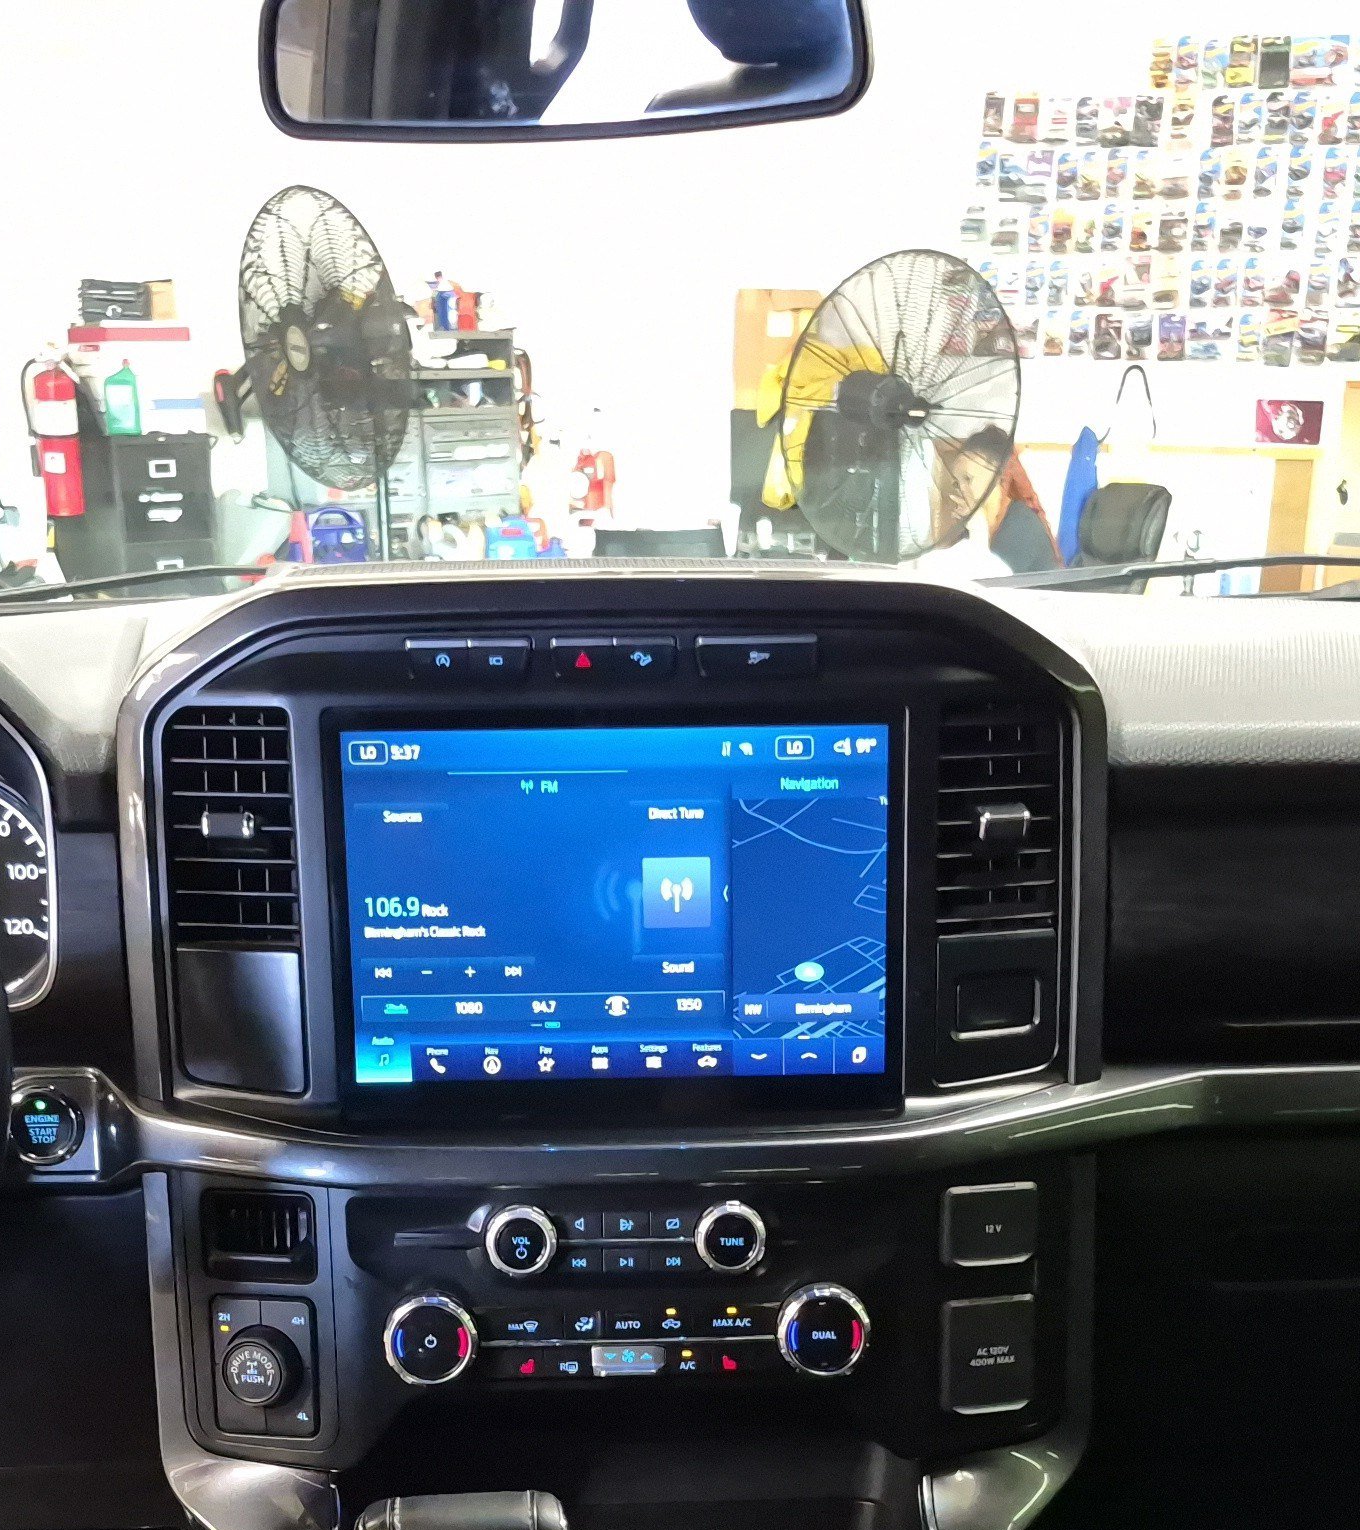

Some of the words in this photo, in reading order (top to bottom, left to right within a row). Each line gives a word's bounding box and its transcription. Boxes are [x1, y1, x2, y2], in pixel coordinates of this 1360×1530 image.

[541, 780, 558, 793] FM
[780, 777, 839, 792] Navigation
[383, 810, 423, 823] Sources
[648, 808, 677, 820] Direct
[679, 807, 704, 819] Tune
[6, 863, 39, 880] 100
[364, 896, 420, 918] 106.9
[421, 904, 449, 917] Rock
[4, 918, 34, 935] 120
[364, 926, 429, 940] Birmingham's
[430, 925, 461, 938] Classic
[462, 925, 486, 937] Rock
[662, 961, 695, 974] Sound
[531, 1000, 557, 1013] 94.7
[795, 1003, 852, 1016] Birmingham
[426, 1047, 449, 1056] Phone
[692, 1043, 722, 1053] Features
[24, 1114, 60, 1124] ENGINE
[29, 1127, 58, 1136] START
[31, 1136, 57, 1144] STOP
[511, 1236, 530, 1246] VOL
[719, 1236, 745, 1247] TUNE
[507, 1323, 524, 1332] MAX
[615, 1320, 641, 1330] AUTO
[712, 1318, 733, 1328] MAX
[734, 1317, 752, 1327] A/C
[811, 1330, 837, 1340] DUAL
[976, 1347, 988, 1357] AC
[231, 1350, 251, 1374] DRIVE
[251, 1350, 275, 1375] MODE
[679, 1361, 696, 1371] A/C
[970, 1357, 995, 1367] 400W
[997, 1355, 1015, 1365] MAX
[241, 1374, 265, 1384] PUSH
[296, 1411, 309, 1421] 4L
